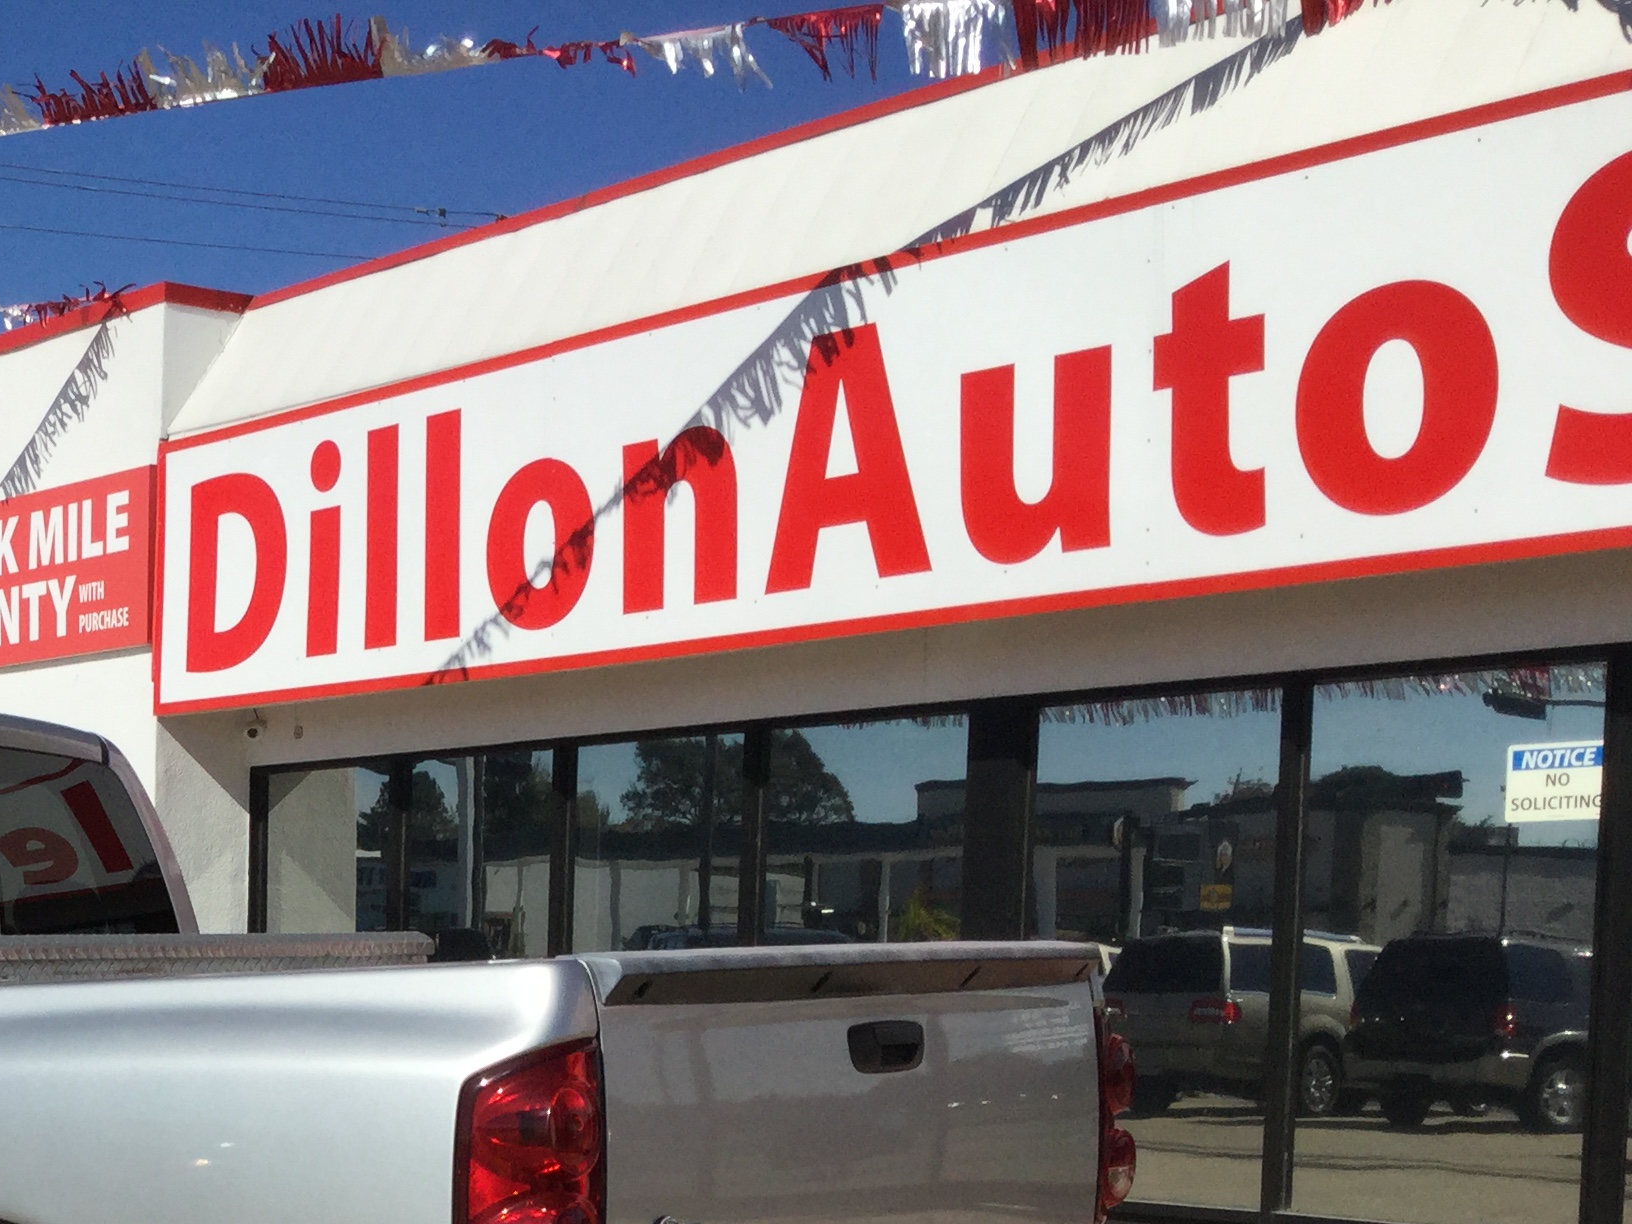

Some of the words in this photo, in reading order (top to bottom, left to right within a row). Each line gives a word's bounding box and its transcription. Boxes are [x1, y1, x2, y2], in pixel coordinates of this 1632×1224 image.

[28, 489, 130, 570] MILE
[78, 580, 105, 603] WITH
[78, 606, 129, 633] PURCHASE
[1521, 747, 1597, 769] NOTICE
[1545, 772, 1570, 787] NO
[1511, 794, 1602, 811] SOLICITING
